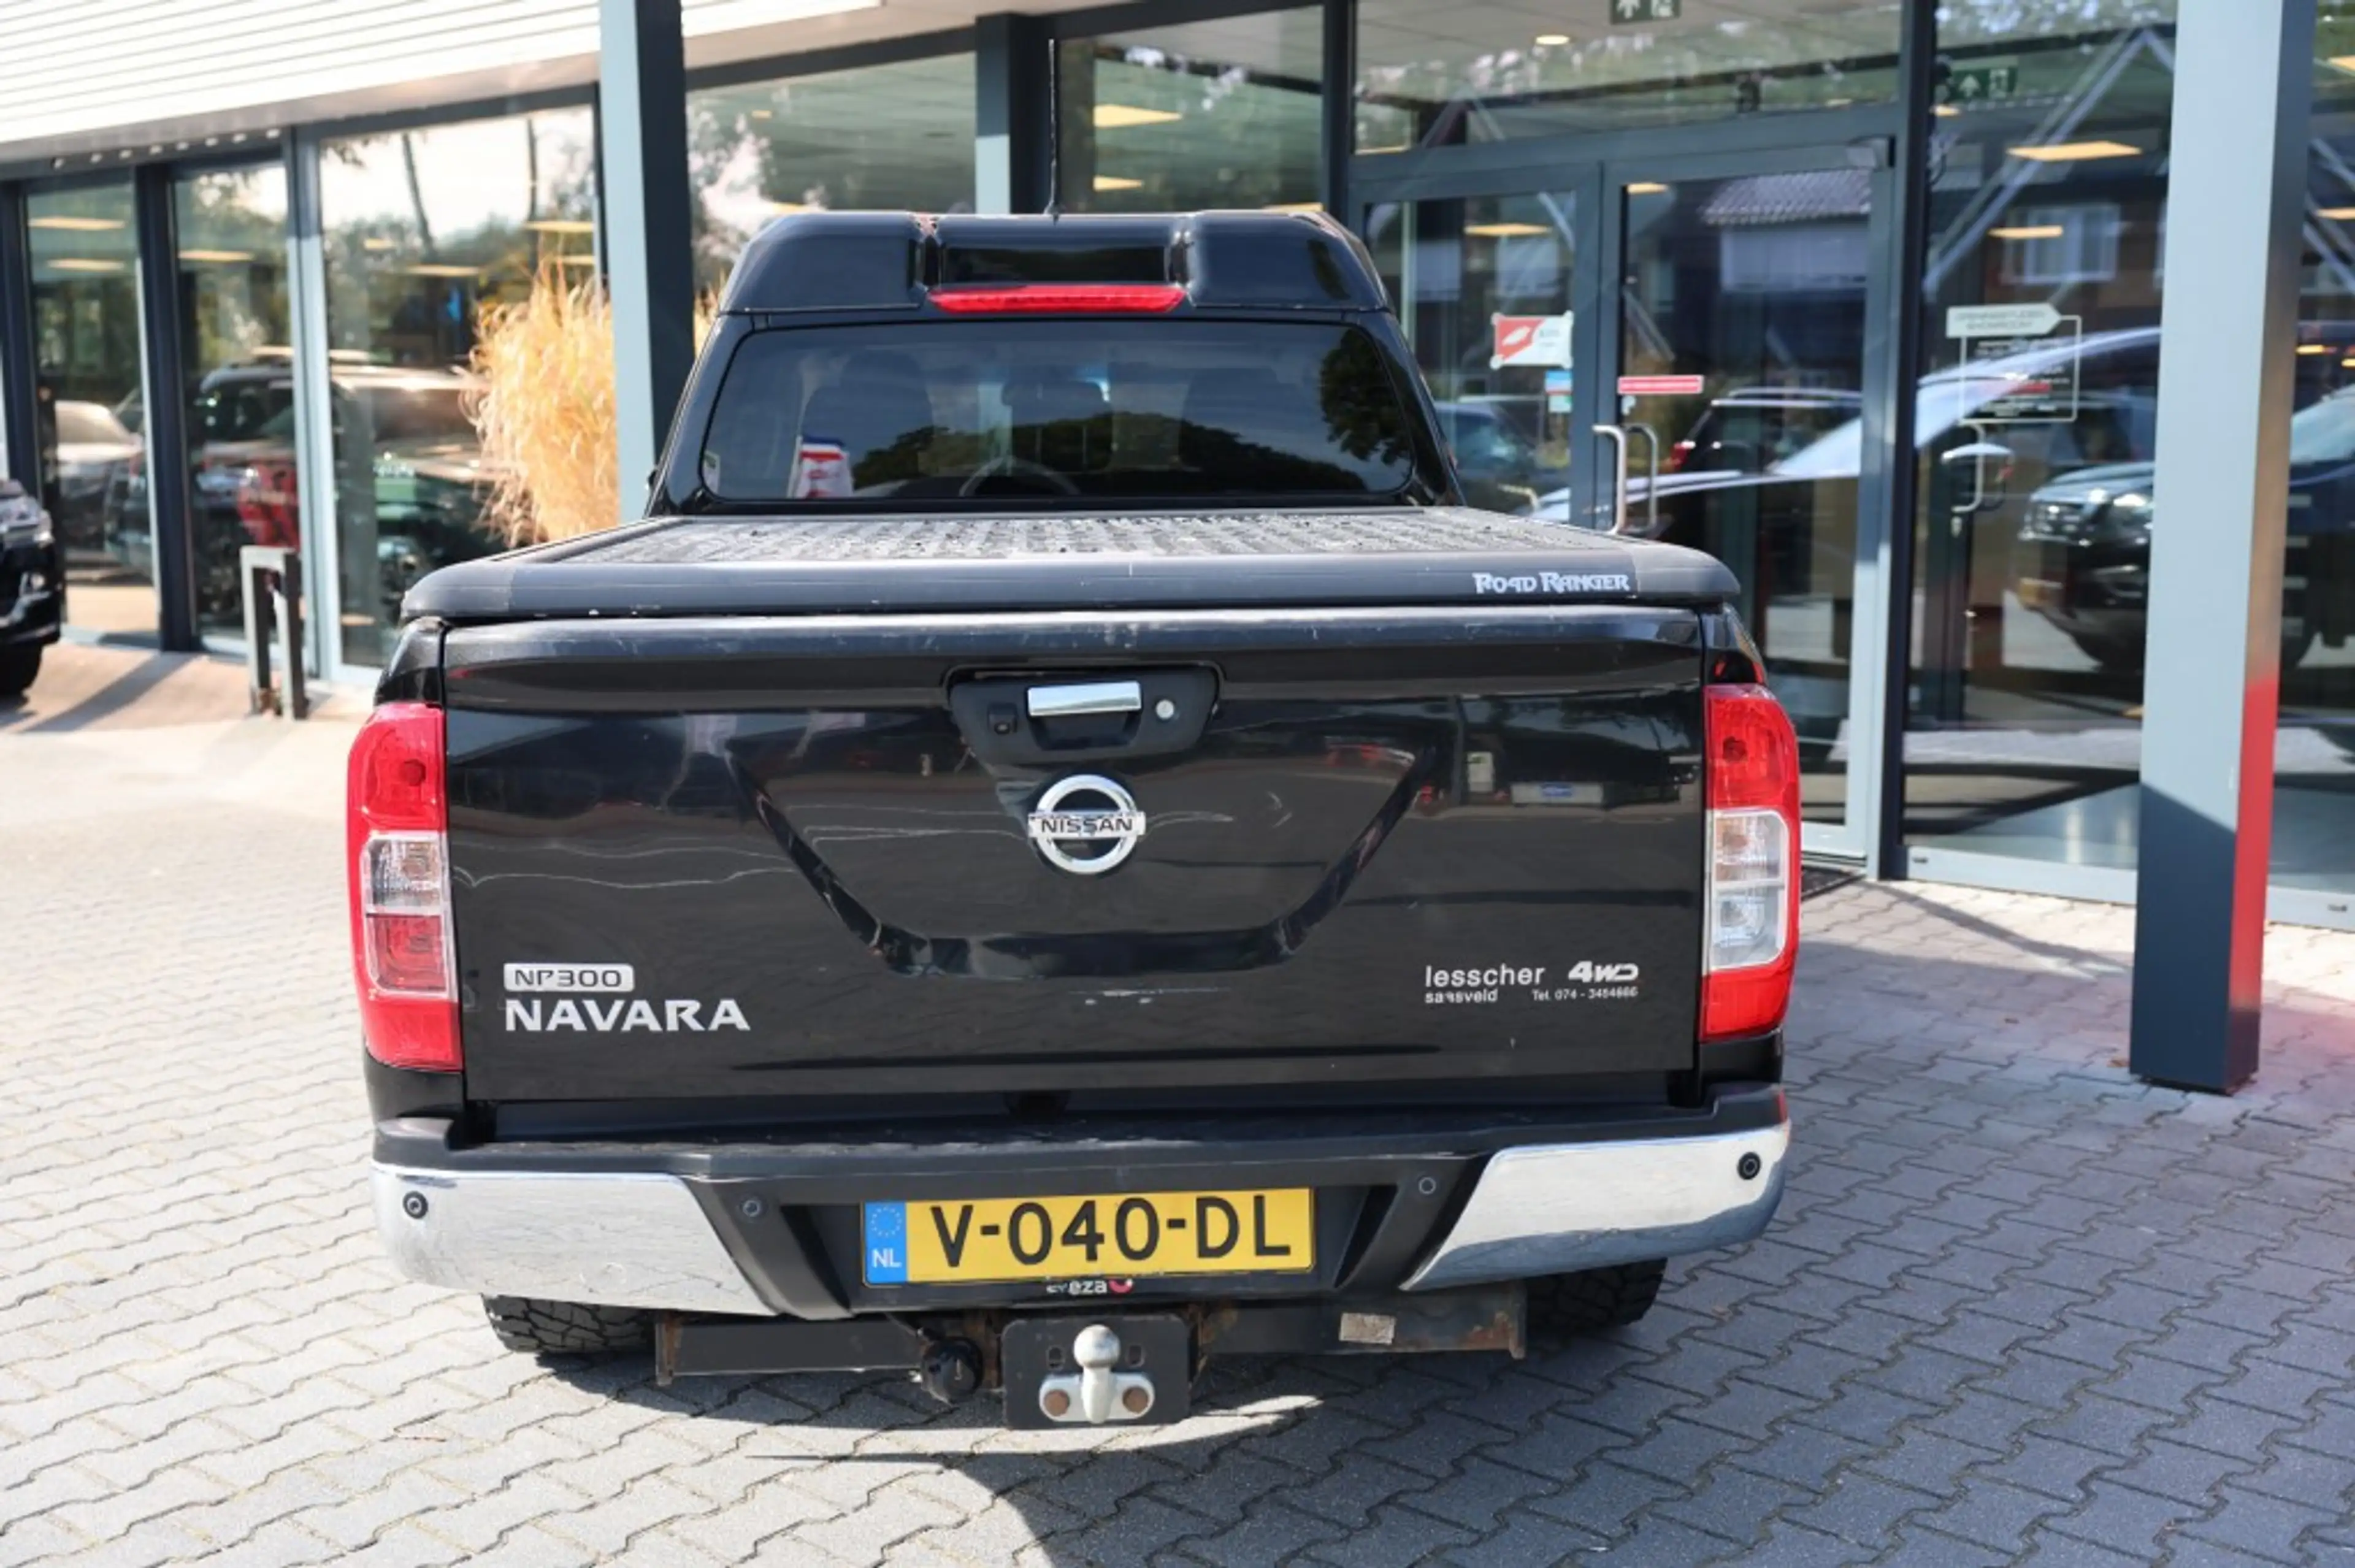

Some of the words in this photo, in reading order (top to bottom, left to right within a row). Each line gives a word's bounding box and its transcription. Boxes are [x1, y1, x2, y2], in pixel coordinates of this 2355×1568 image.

[1472, 572, 1537, 594] ROAD
[1539, 572, 1630, 594] RANGER
[1042, 818, 1132, 833] NISSAN
[515, 969, 622, 987] NP300
[1425, 963, 1545, 987] lesscher
[1568, 960, 1639, 982] 4WD
[505, 999, 751, 1031] NAVARA
[930, 1195, 1292, 1268] V-040-DL
[871, 1249, 902, 1268] NL
